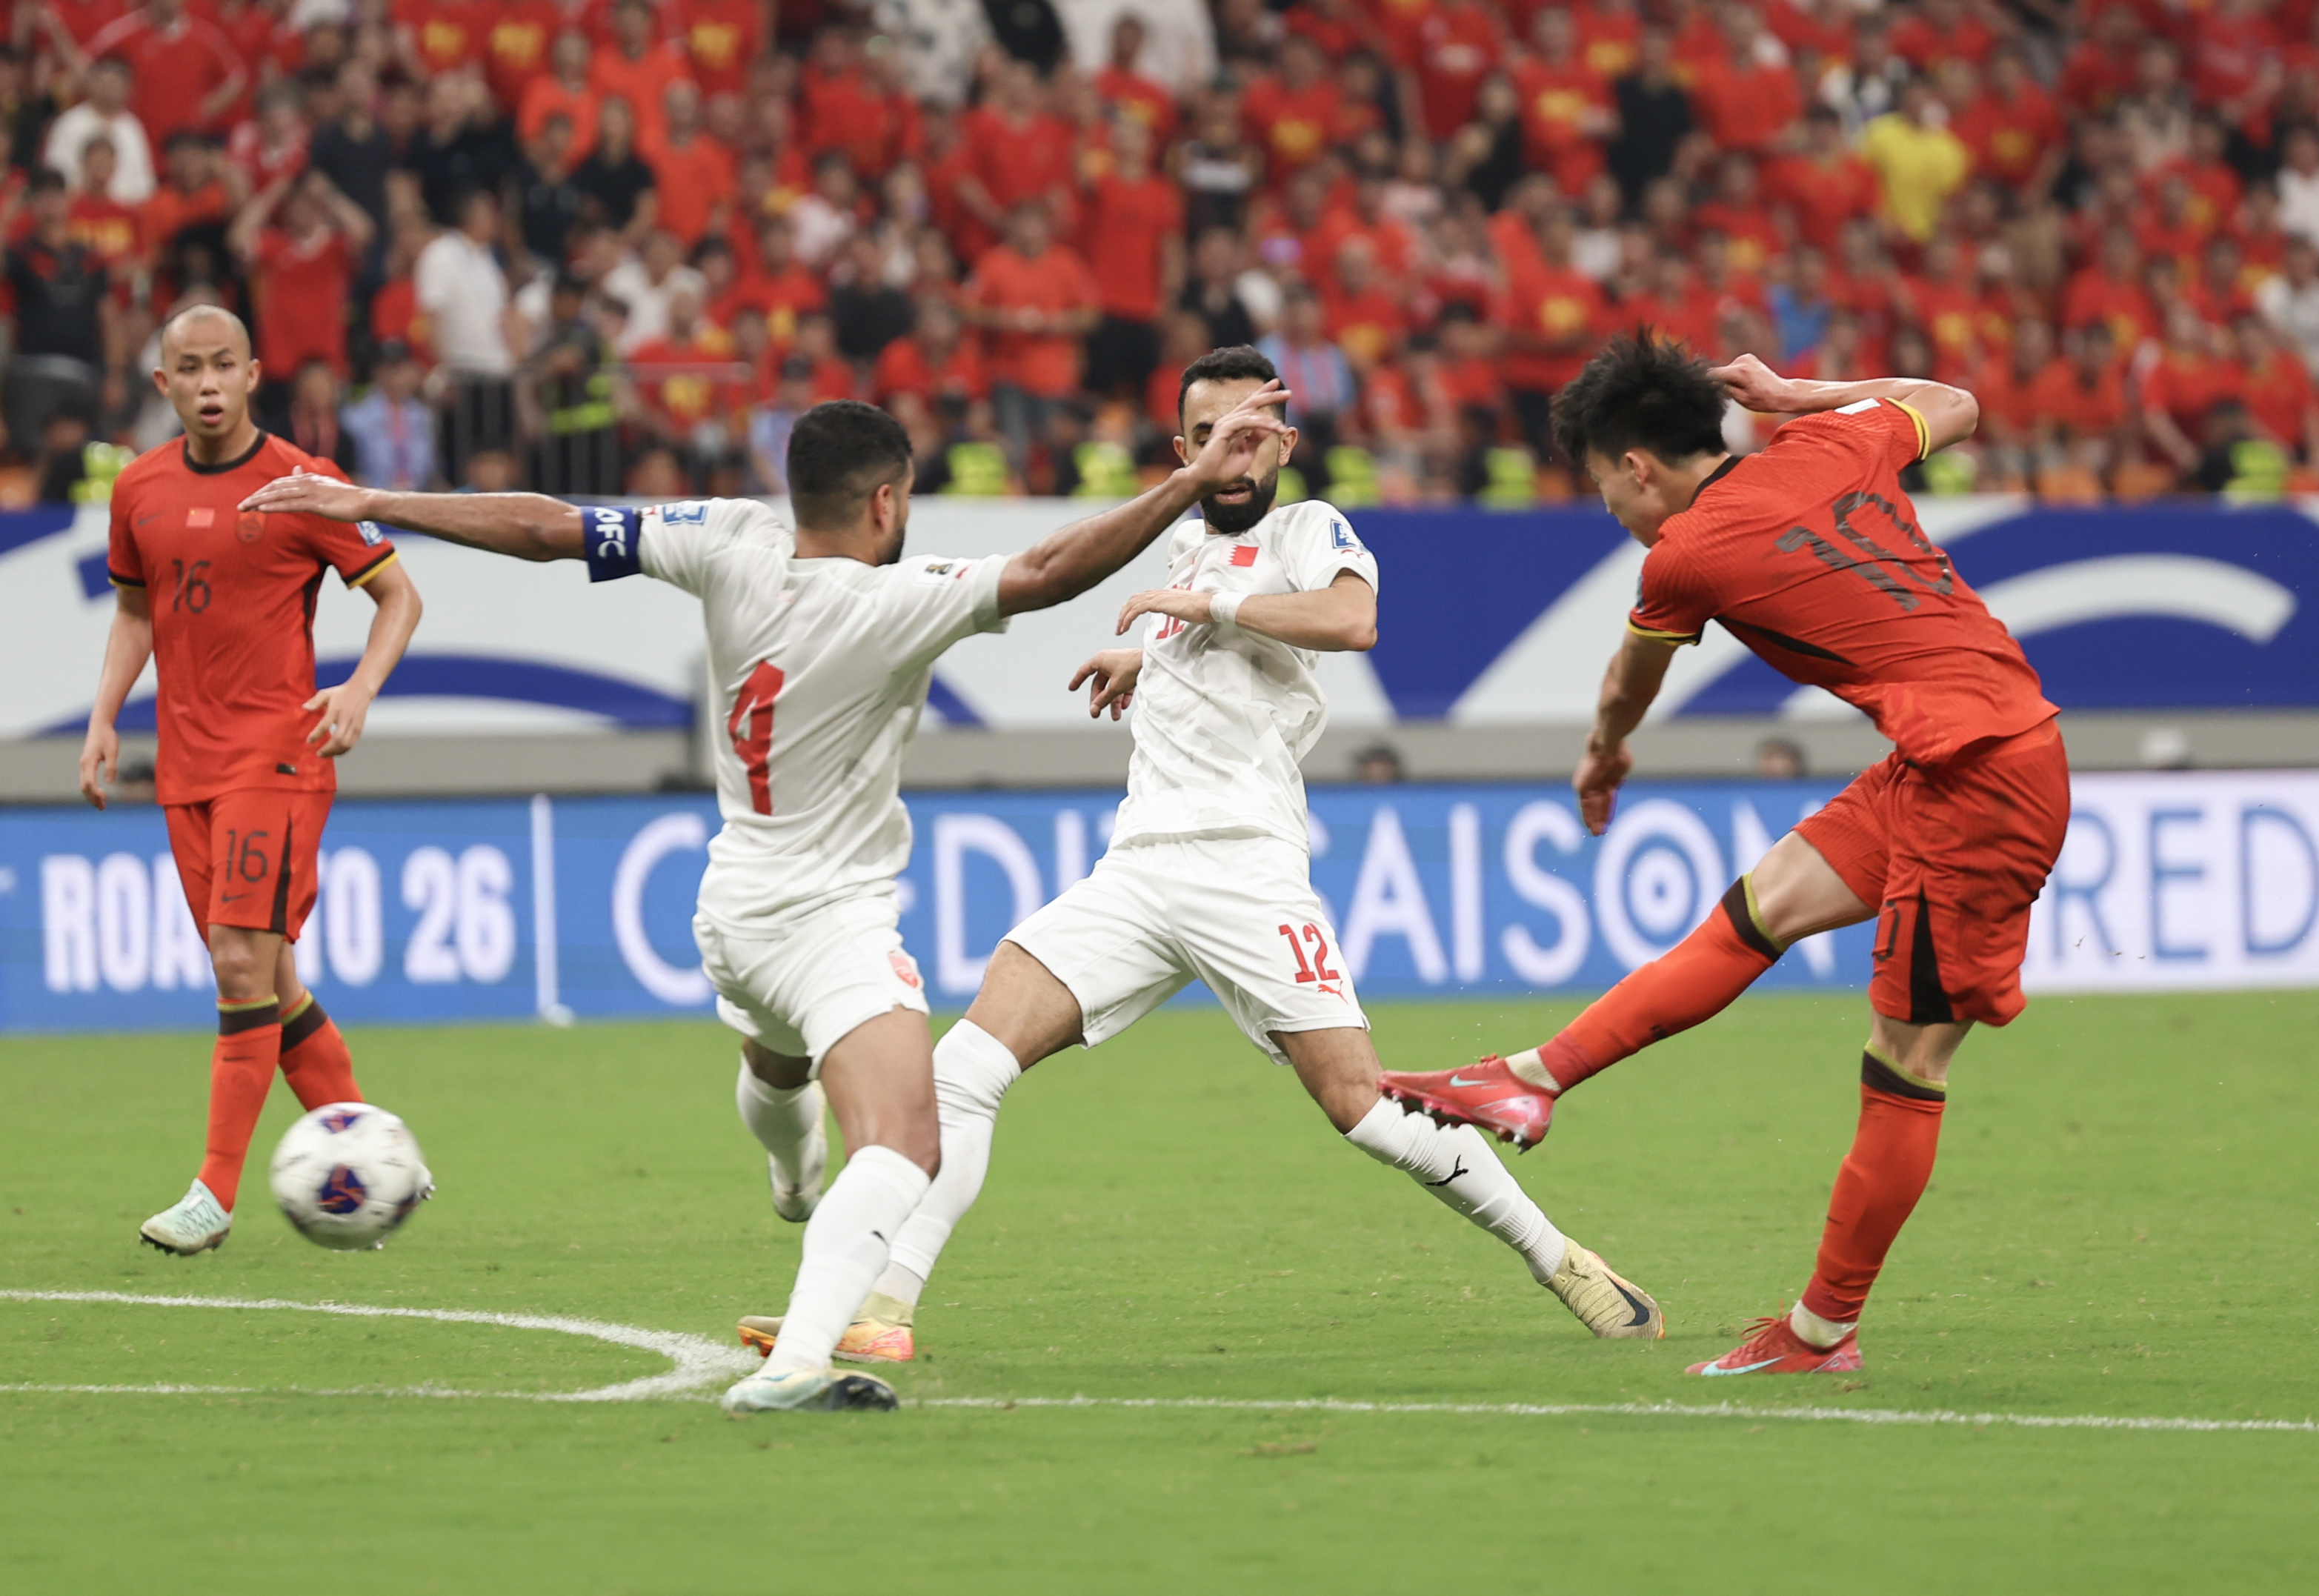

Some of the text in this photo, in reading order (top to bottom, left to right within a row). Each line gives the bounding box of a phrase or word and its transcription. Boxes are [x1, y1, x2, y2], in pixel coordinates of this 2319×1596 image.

[172, 559, 211, 614] 16
[594, 508, 626, 559] AFC
[1775, 490, 1953, 613] 10
[728, 659, 785, 816] 4
[225, 829, 268, 884] 16
[1306, 799, 1835, 985] AISO
[2023, 805, 2319, 967] RED
[41, 852, 217, 992] ROA
[402, 845, 516, 985] 26
[1279, 923, 1340, 983] 12
